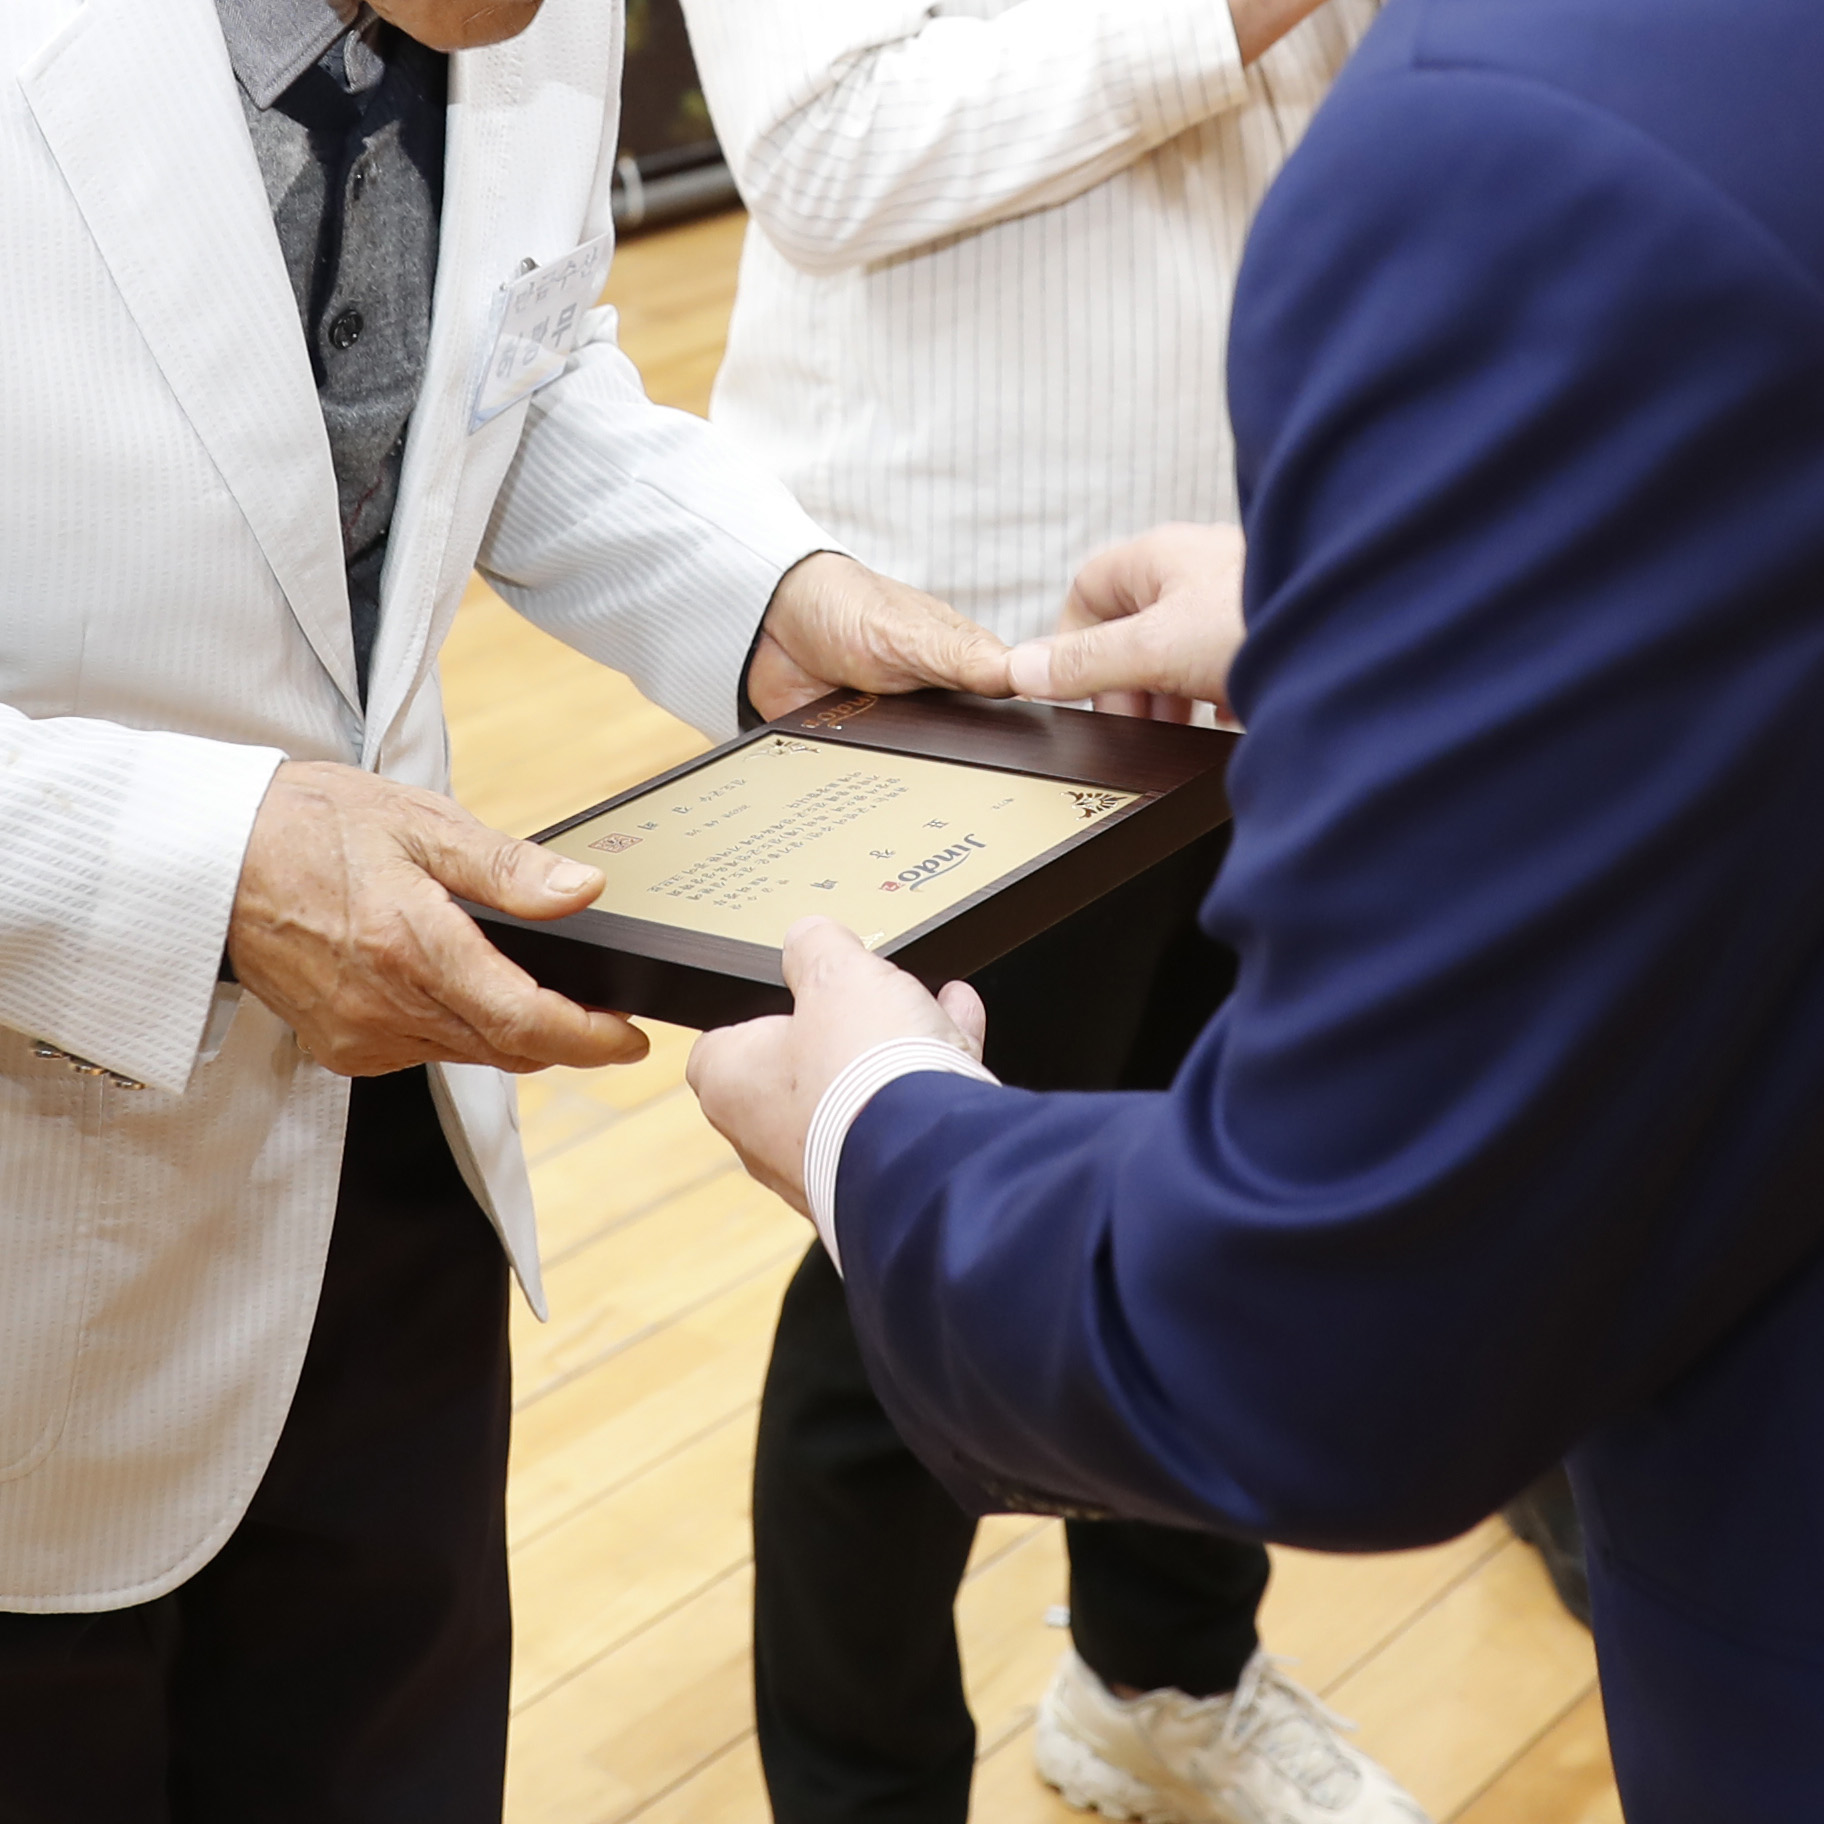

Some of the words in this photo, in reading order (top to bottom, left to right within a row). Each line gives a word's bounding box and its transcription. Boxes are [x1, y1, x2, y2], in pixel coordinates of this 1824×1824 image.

[699, 779, 746, 801] 진도군수
[793, 803, 827, 818] 진도군
[739, 819, 796, 845] 인재육성에
[923, 819, 949, 829] 표
[869, 849, 895, 859] 창
[898, 834, 986, 884] Jindo
